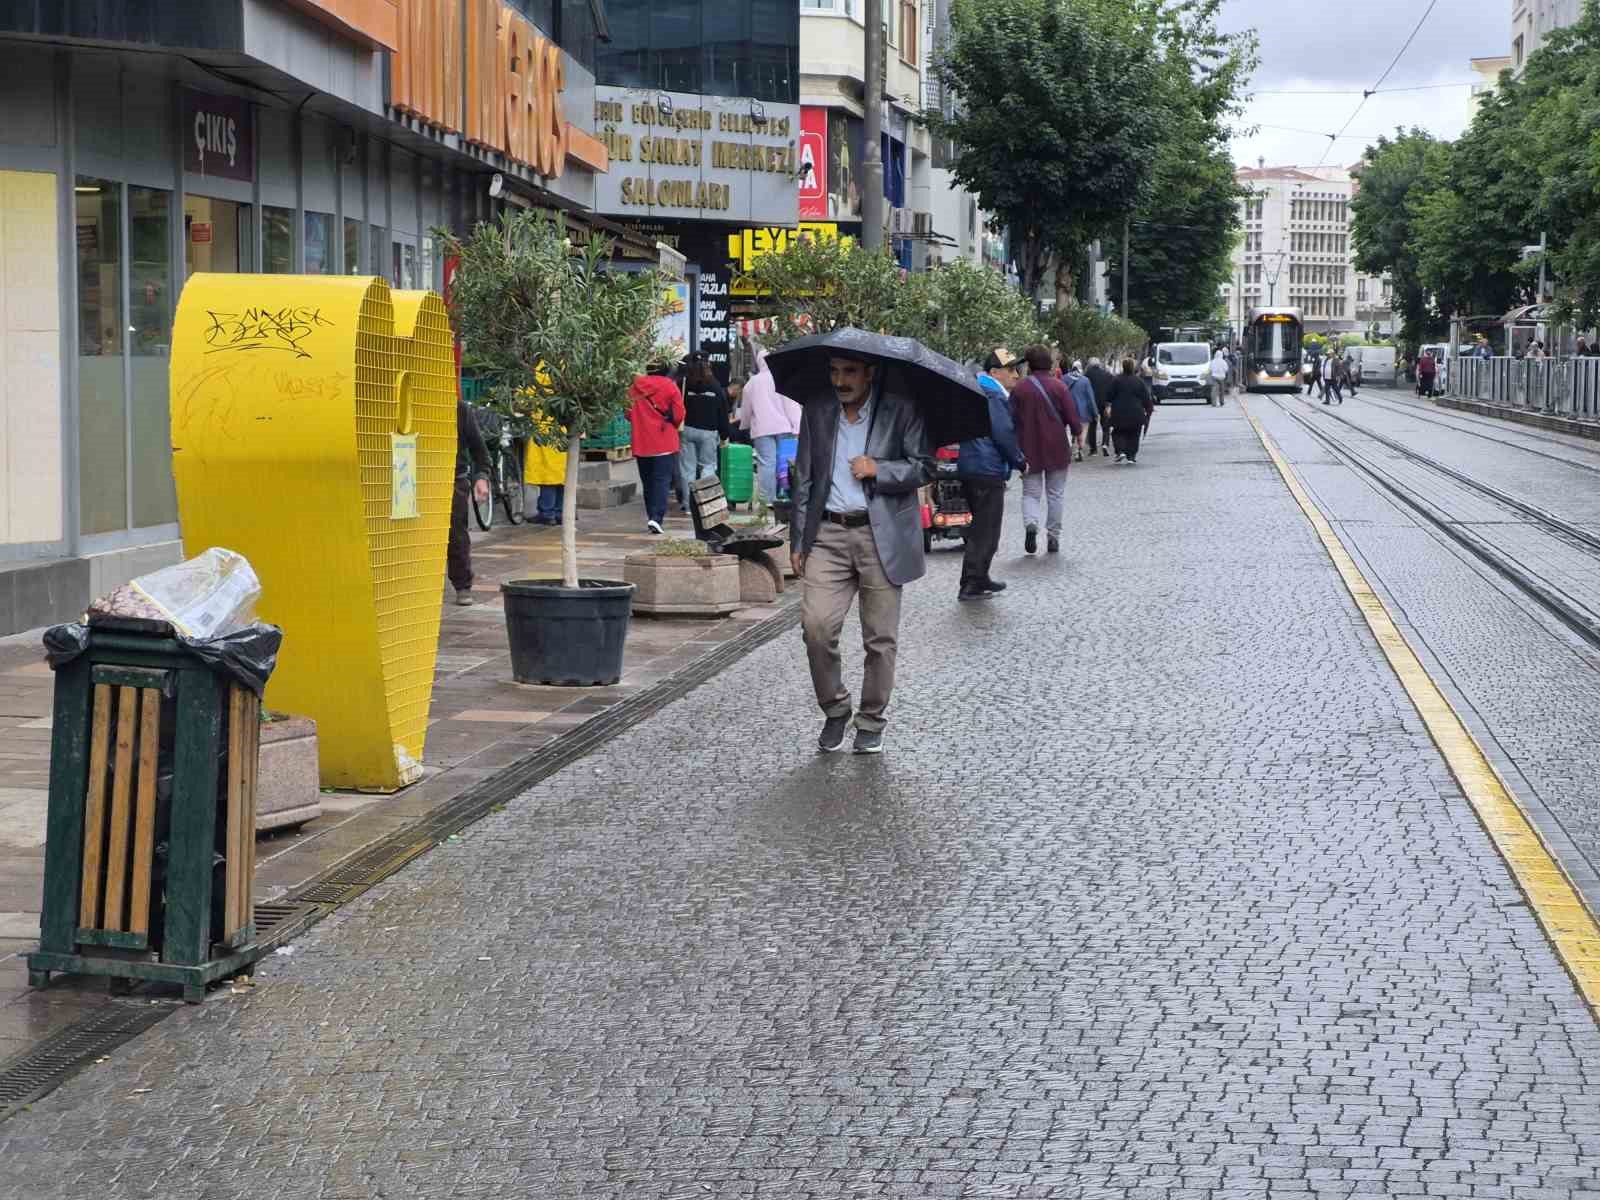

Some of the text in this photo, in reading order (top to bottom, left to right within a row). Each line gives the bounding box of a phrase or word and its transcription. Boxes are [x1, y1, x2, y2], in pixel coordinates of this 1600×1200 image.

[194, 111, 237, 168] ÇIKIŞ
[719, 112, 790, 137] BELEDESİ
[640, 136, 703, 166] SANAT
[712, 138, 796, 175] MERKEZİ
[621, 176, 730, 211] SALONLARI
